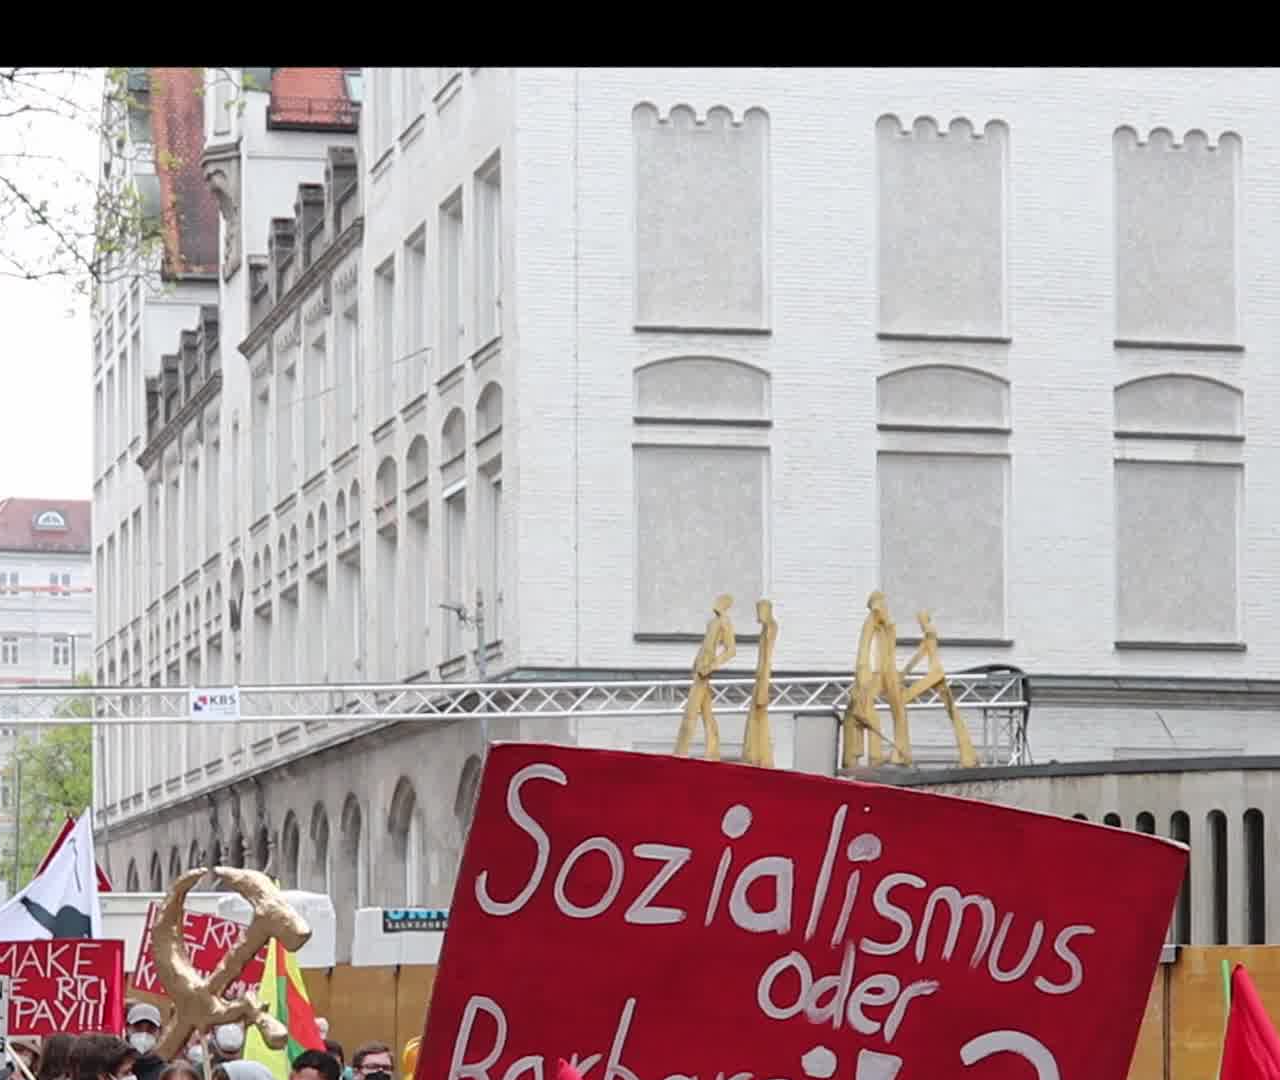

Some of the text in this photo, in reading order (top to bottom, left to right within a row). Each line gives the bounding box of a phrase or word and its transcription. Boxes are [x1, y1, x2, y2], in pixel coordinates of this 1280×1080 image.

[474, 763, 1096, 995] Sozialismus
[13, 998, 105, 1032] PAY!!!
[757, 942, 940, 1043] oder
